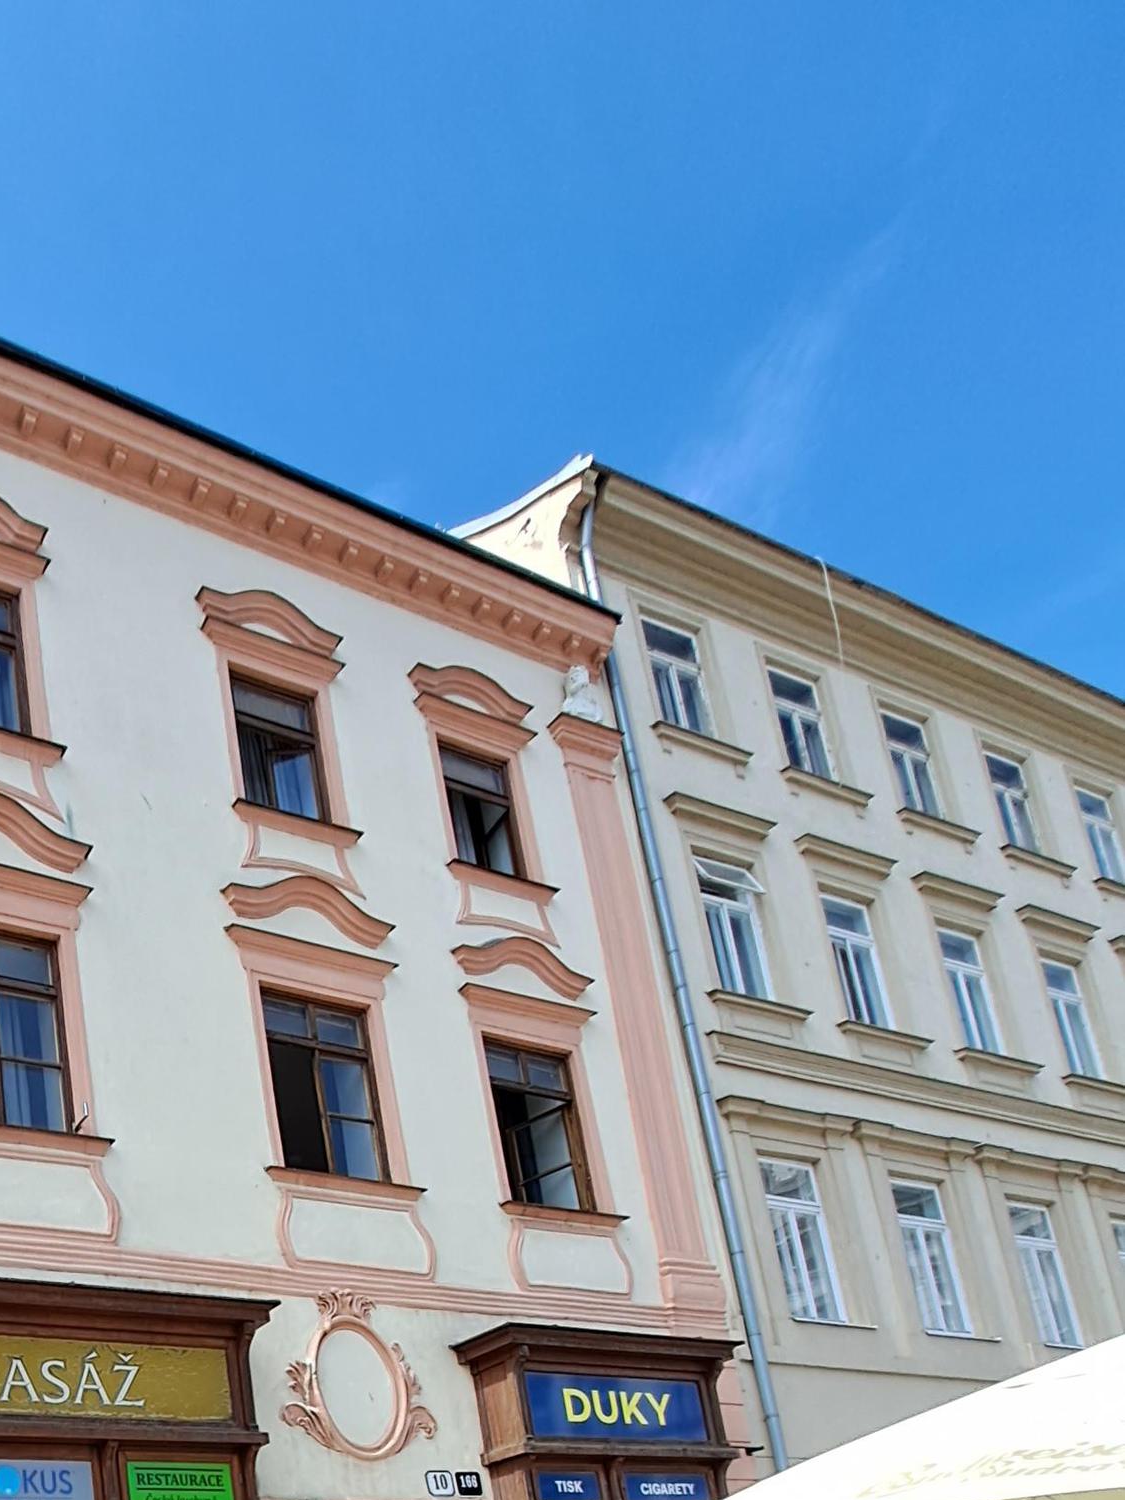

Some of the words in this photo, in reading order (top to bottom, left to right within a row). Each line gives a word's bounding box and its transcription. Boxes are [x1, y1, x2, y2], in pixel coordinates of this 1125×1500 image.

[562, 1388, 671, 1427] DUKY
[136, 1472, 225, 1487] RESTAURACE
[433, 1474, 449, 1490] 10
[555, 1480, 585, 1493] TISK
[640, 1483, 695, 1496] CIGARETY
